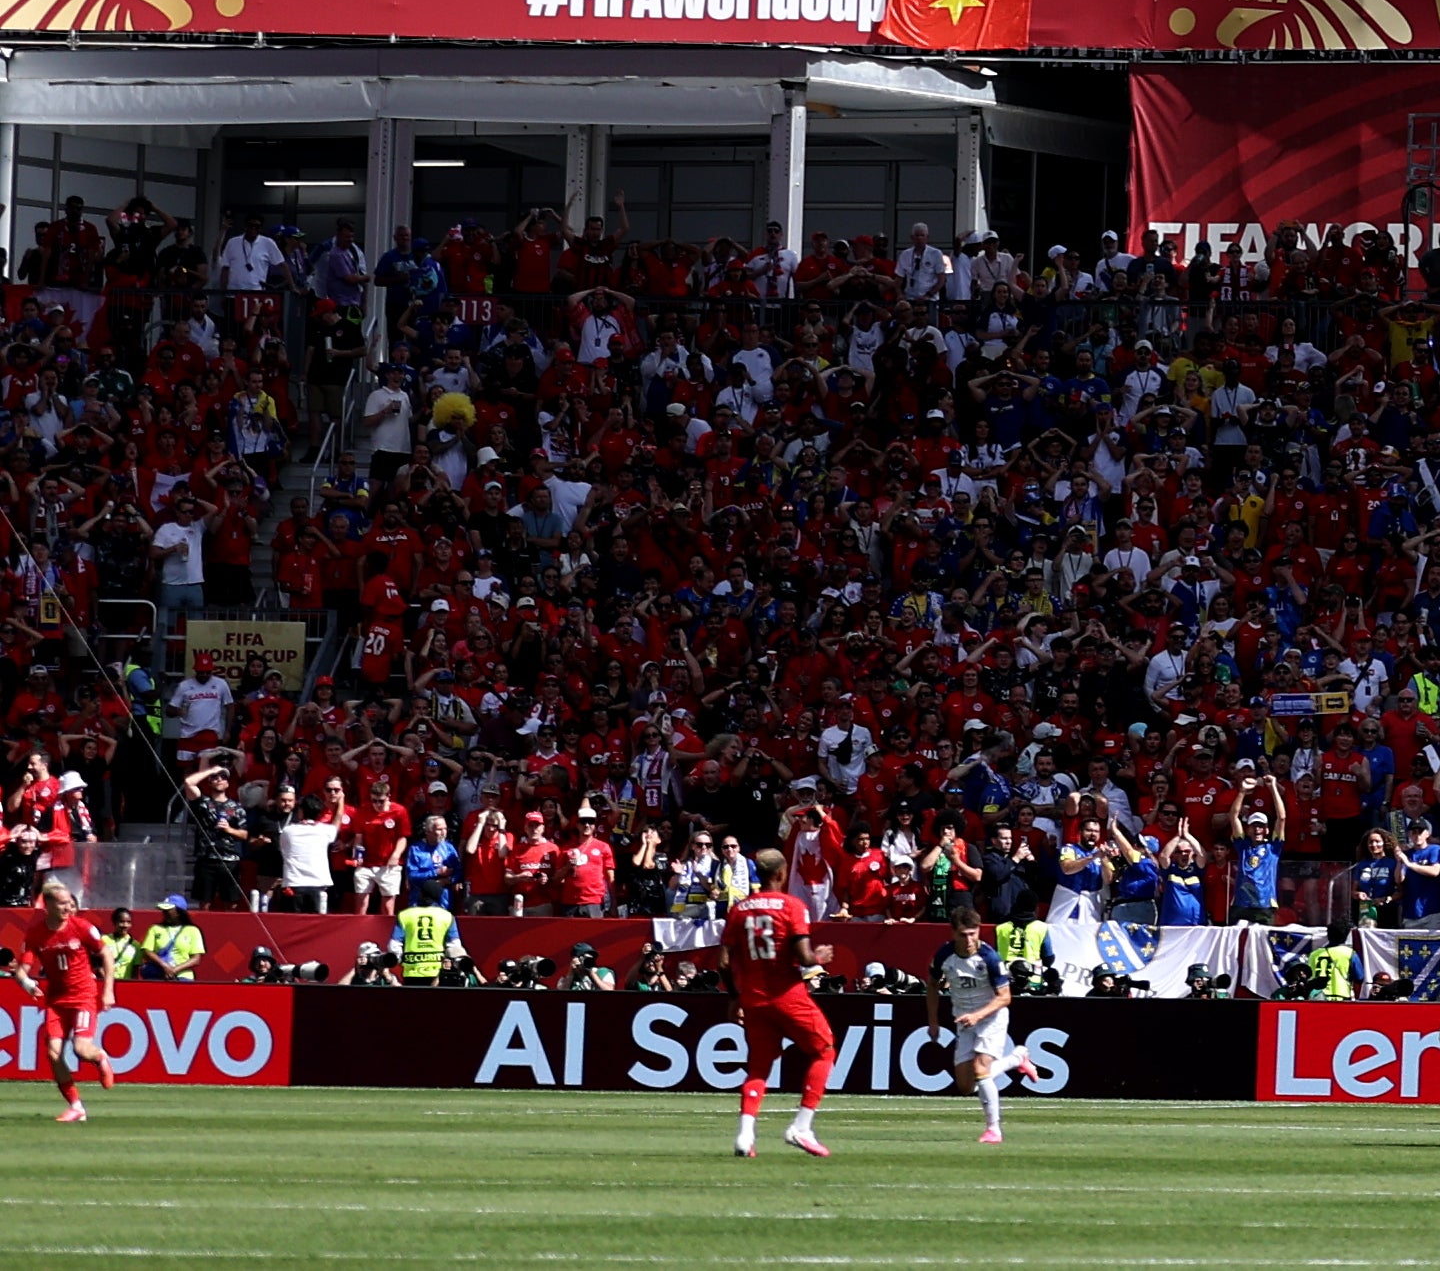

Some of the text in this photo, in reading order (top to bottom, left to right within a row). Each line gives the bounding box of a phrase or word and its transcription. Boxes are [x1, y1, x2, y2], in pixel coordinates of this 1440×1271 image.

[1150, 221, 1268, 269] FIFA
[461, 298, 493, 323] 113
[225, 632, 264, 647] FIFA
[364, 635, 385, 656] 20
[257, 649, 299, 664] CUP
[1323, 771, 1358, 782] CANADA
[746, 914, 774, 960] 13
[58, 954, 69, 969] 11
[959, 977, 976, 988] 20
[0, 1005, 273, 1078] novo
[475, 1001, 586, 1086] AI
